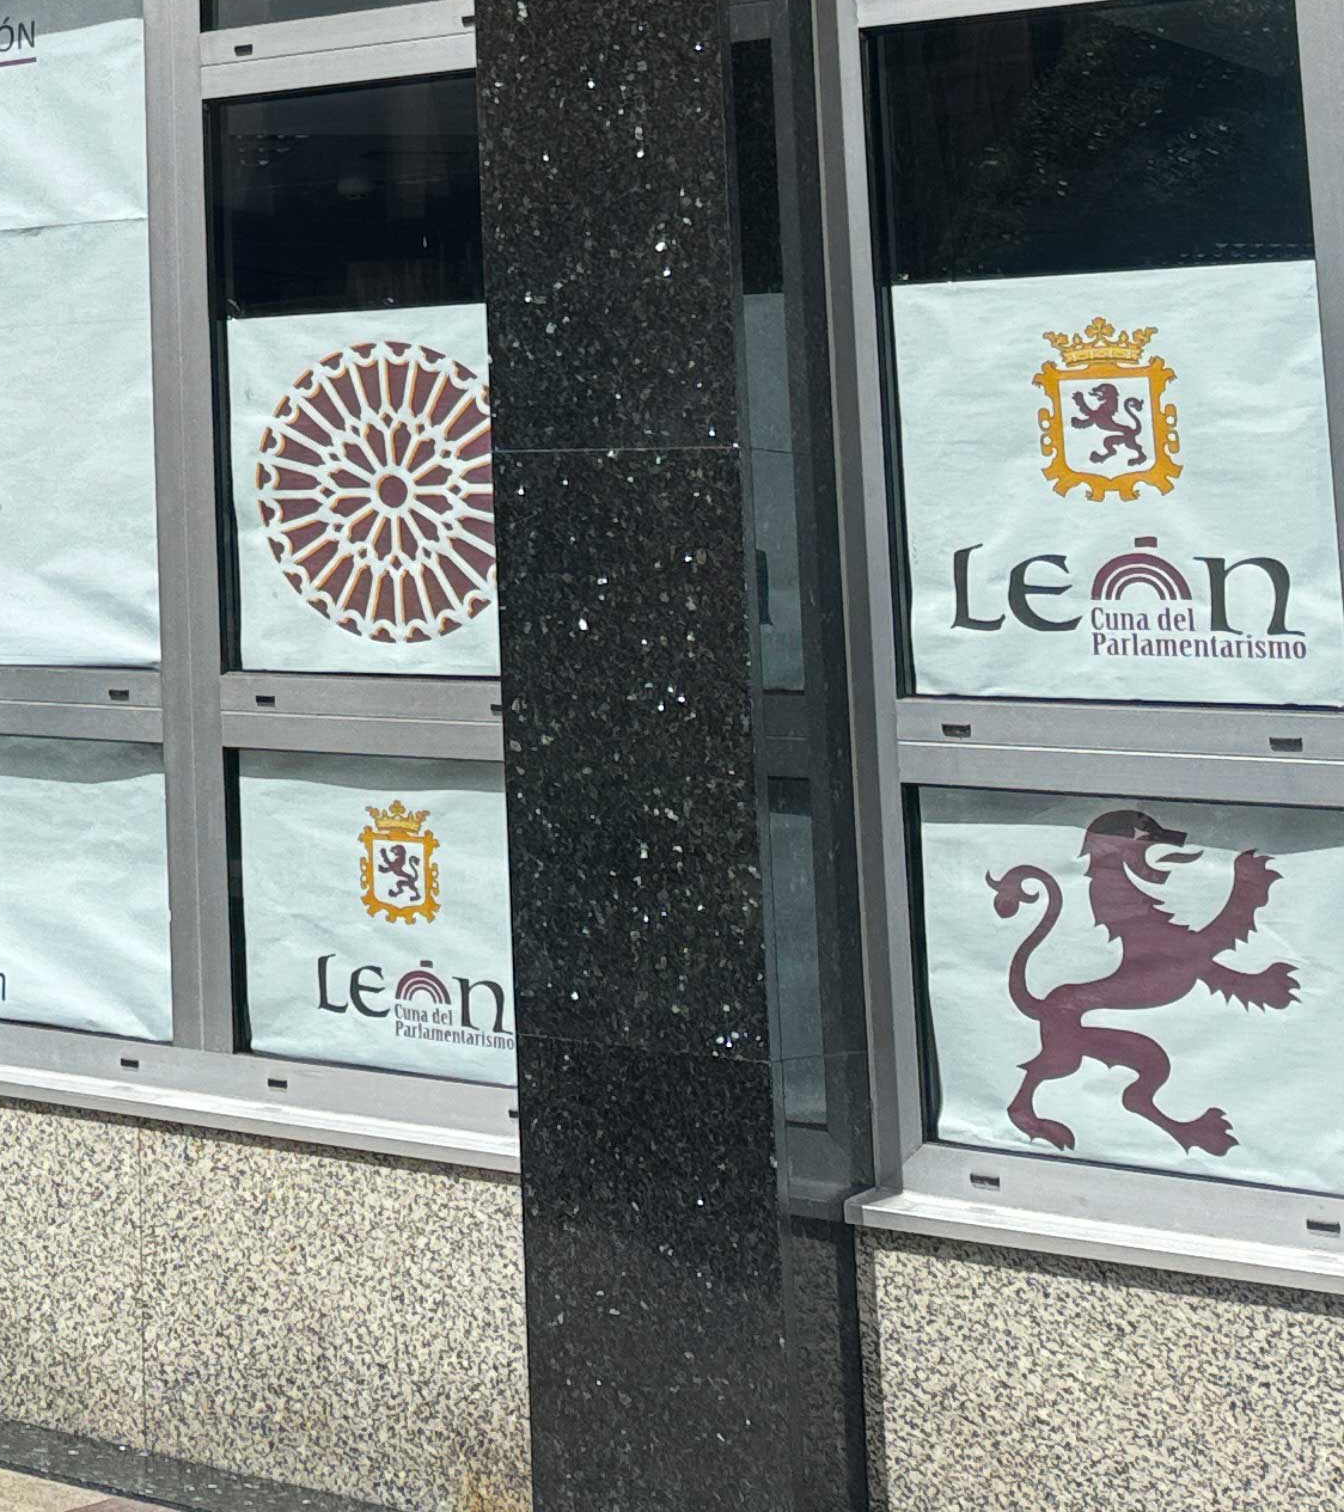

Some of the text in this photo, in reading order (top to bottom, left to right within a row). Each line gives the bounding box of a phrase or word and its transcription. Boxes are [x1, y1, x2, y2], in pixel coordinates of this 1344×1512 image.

[1090, 606, 1196, 633] Cuna del
[1091, 631, 1307, 660] Parlamentarismo
[393, 1003, 454, 1027] Cuna del
[394, 1022, 515, 1051] Parlamentarismo
